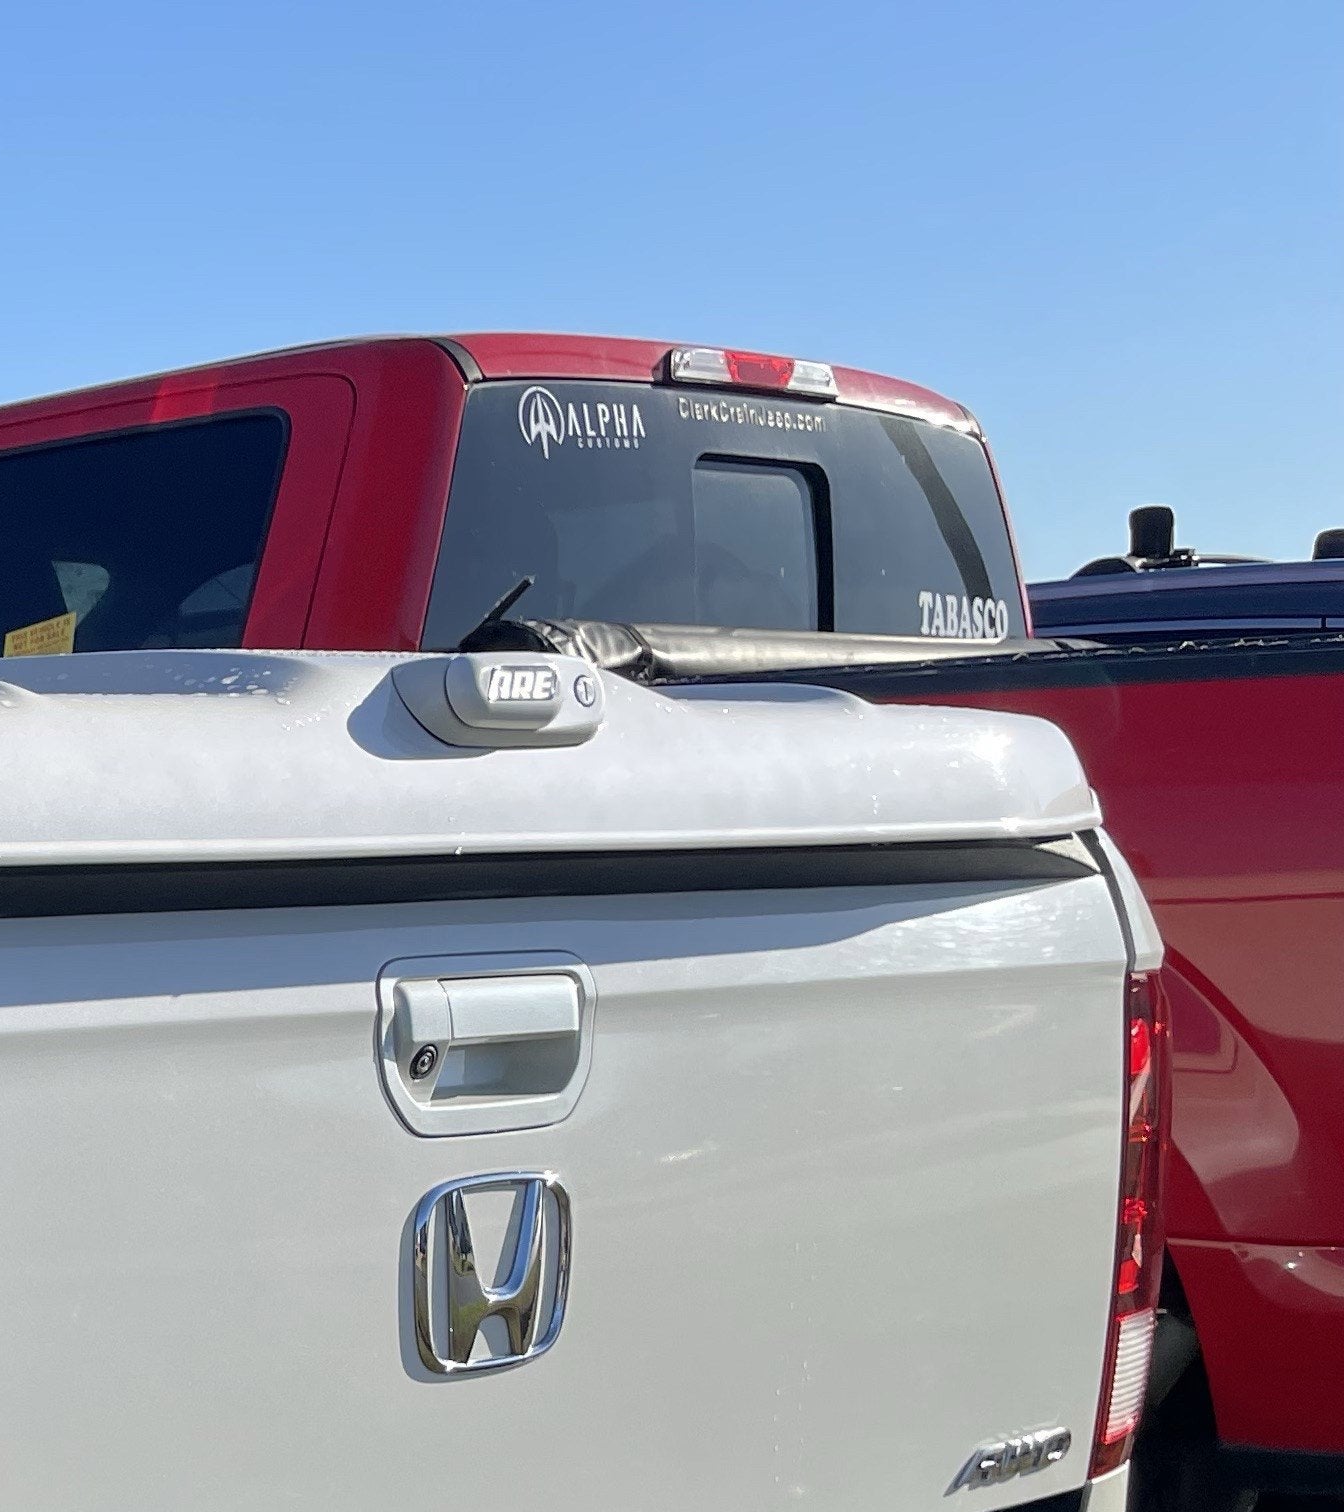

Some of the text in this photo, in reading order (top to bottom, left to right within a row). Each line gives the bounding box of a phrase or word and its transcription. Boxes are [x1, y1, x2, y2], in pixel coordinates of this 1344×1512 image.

[567, 402, 646, 438] ALPHA
[918, 590, 1009, 640] TABASCO
[488, 669, 553, 702] ARE
[948, 1426, 1072, 1495] AWD
